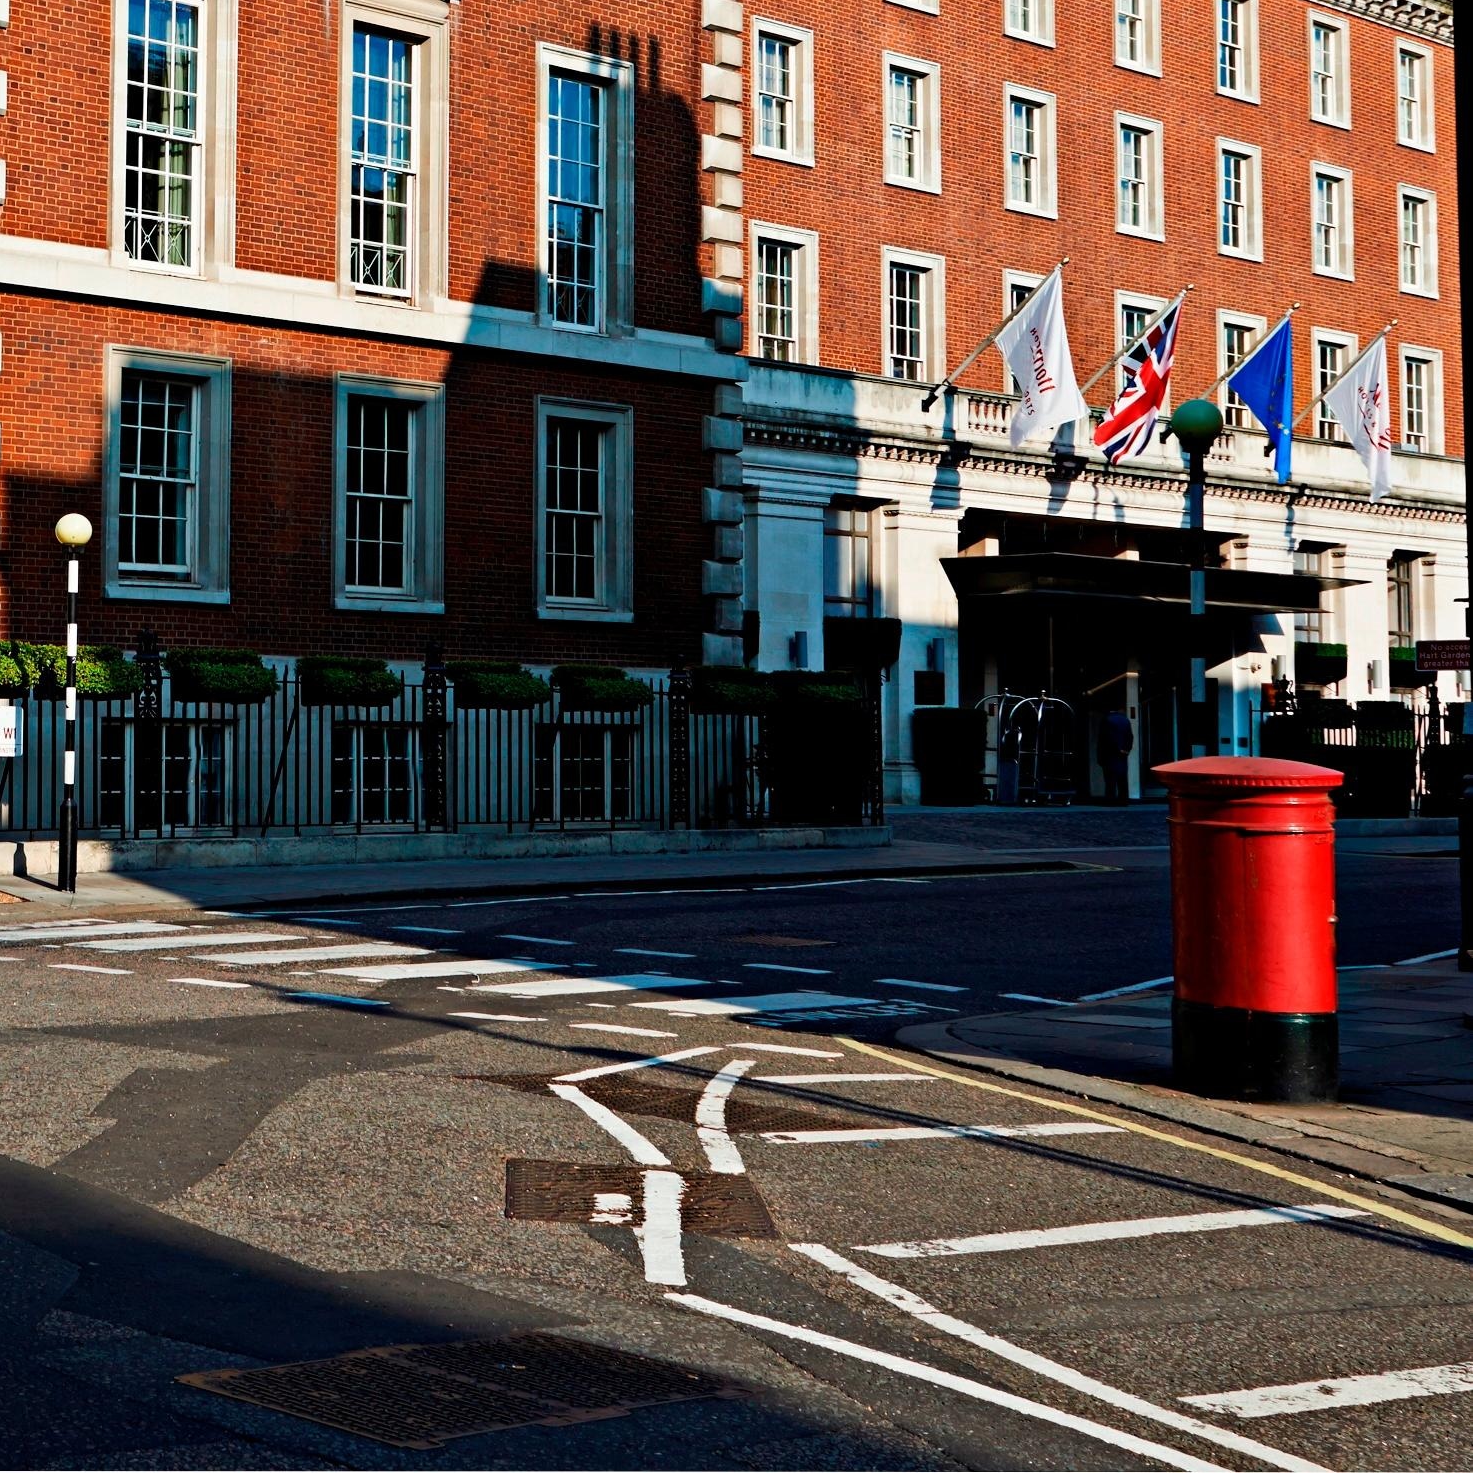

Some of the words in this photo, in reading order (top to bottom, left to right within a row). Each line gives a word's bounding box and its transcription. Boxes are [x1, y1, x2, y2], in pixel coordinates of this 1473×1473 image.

[1430, 643, 1443, 651] No
[1419, 651, 1438, 659] Hart
[1423, 660, 1453, 669] greater
[3, 727, 17, 740] W1
